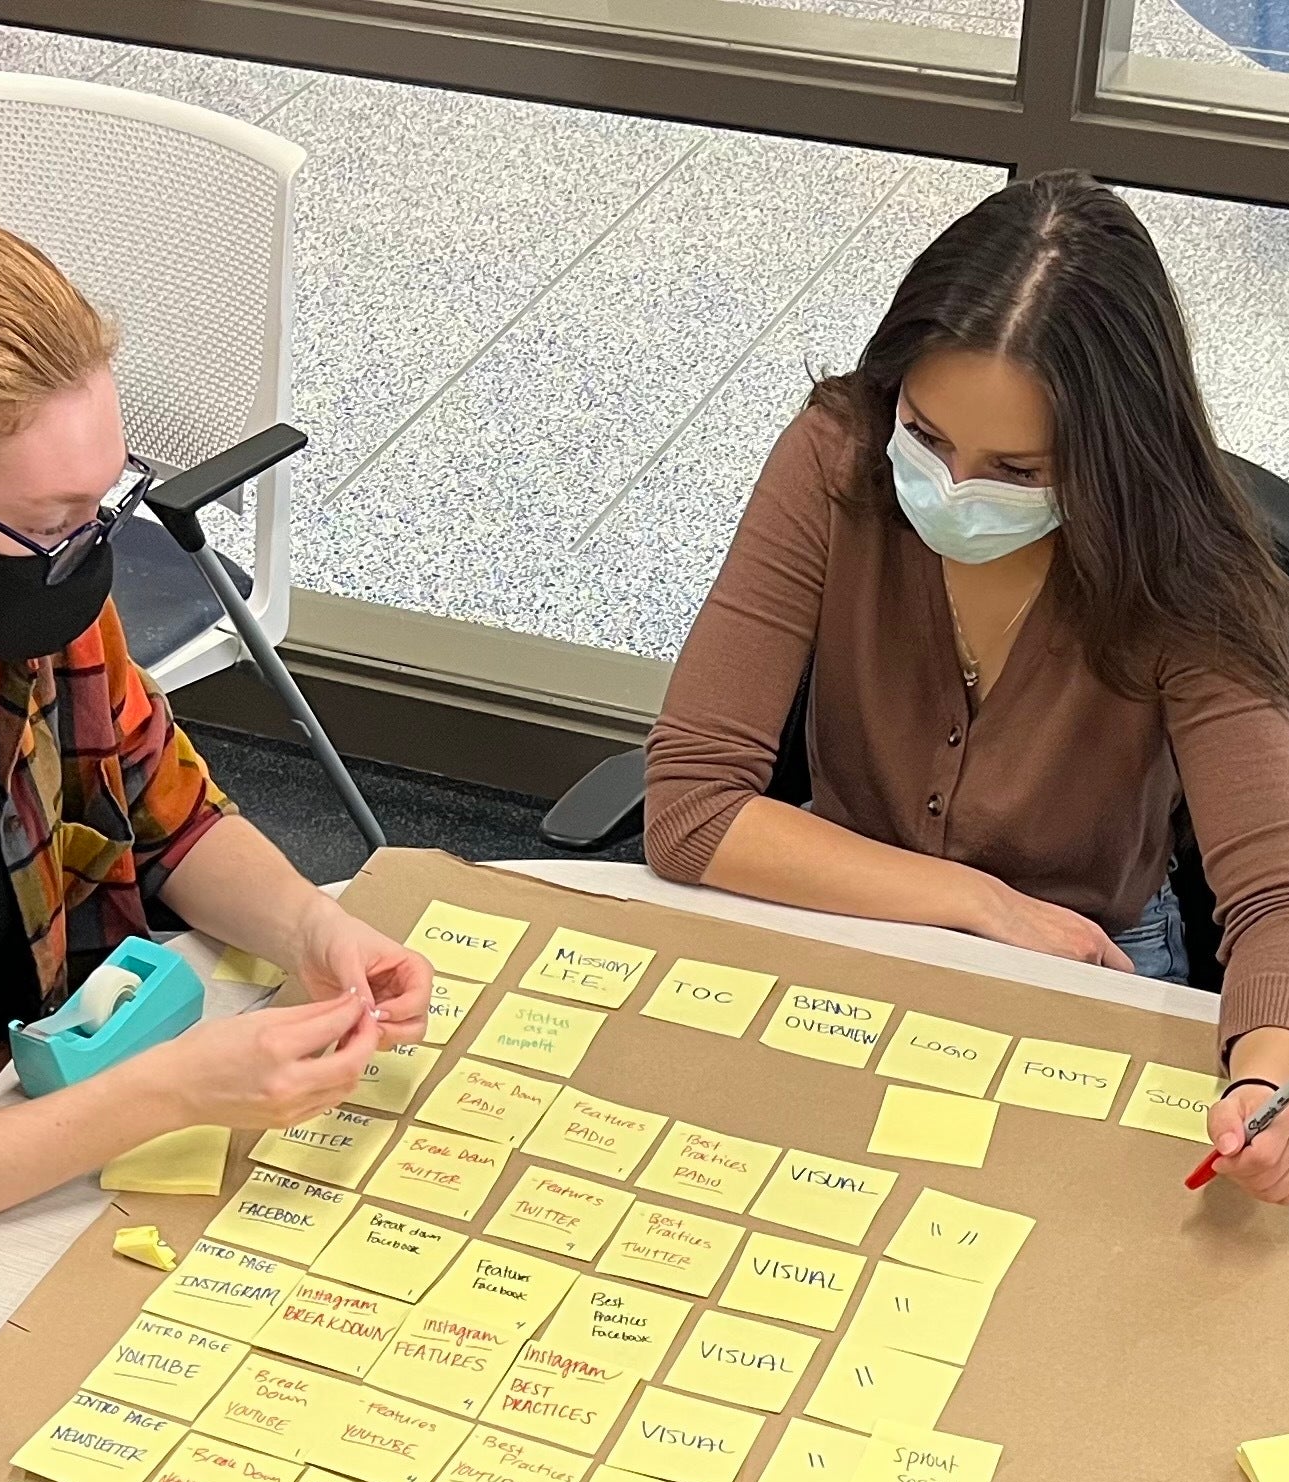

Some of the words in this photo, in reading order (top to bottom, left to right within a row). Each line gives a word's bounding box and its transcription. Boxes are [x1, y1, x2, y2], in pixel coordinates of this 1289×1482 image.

[424, 925, 499, 953] COVER
[673, 978, 734, 1004] TOC
[784, 1015, 879, 1047] OVERVIEW
[909, 1034, 979, 1062] LOGO
[1023, 1060, 1109, 1090] FONTS
[336, 1110, 375, 1128] PAGE
[456, 1091, 507, 1117] RADIO
[564, 1121, 616, 1148] RADIO
[251, 1169, 300, 1191] INTRO
[303, 1184, 345, 1205] PAGE
[397, 1162, 463, 1186] TWITTER
[673, 1166, 723, 1188] RADIO
[790, 1163, 880, 1196] VISUAL
[237, 1200, 316, 1228] FACEBOOK
[515, 1199, 582, 1228] TWITTER
[194, 1240, 236, 1261] INTRO
[238, 1253, 280, 1275] PAGE
[621, 1240, 692, 1266] TWITTER
[175, 1274, 282, 1307] INSTAGRAM
[753, 1256, 845, 1293] VISUAL
[589, 1291, 626, 1309] Best
[135, 1318, 184, 1340] INTRO
[188, 1333, 233, 1354] PAGE
[282, 1304, 397, 1343] BREAKDOWN
[115, 1344, 202, 1380] YOUTUBE
[393, 1340, 488, 1373] FEATURES
[700, 1338, 795, 1374] VISUAL
[509, 1377, 556, 1399] BEST
[73, 1392, 121, 1416] INTRO
[123, 1411, 169, 1433] PAGE
[224, 1400, 292, 1433] YOUTUBE
[501, 1394, 599, 1427] PRACTICES
[49, 1424, 149, 1463] NEWSLETTER
[342, 1423, 420, 1458] YOUTUBE
[640, 1419, 737, 1456] VISUAL
